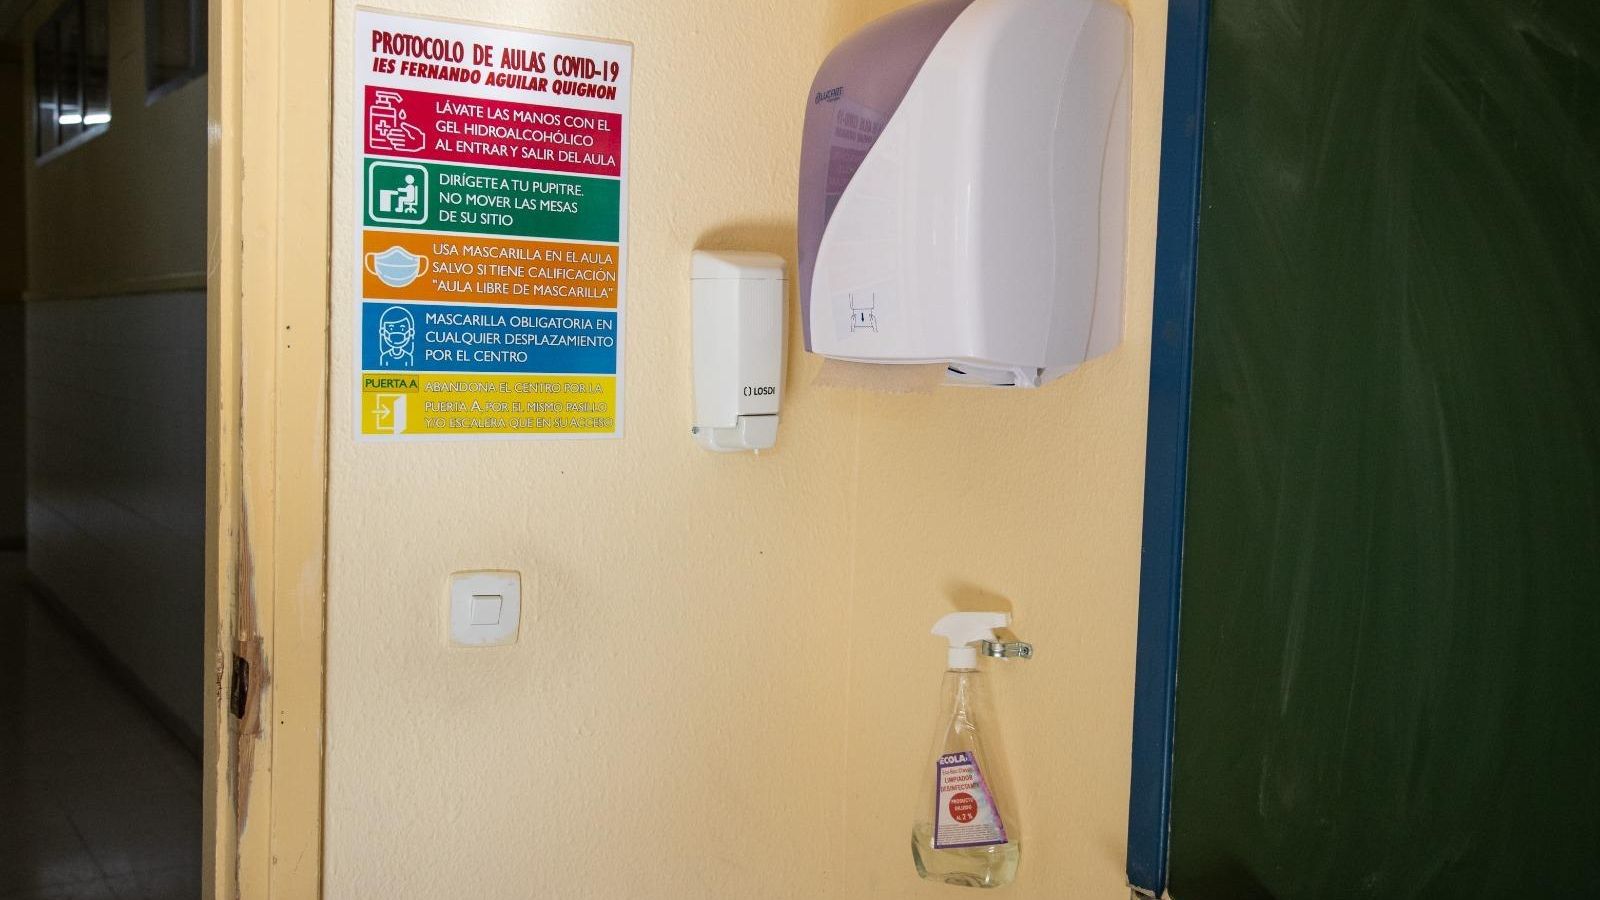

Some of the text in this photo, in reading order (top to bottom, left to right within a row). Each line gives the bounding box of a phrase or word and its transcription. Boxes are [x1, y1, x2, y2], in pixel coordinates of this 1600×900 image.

[372, 30, 619, 82] PROTOCOLO DE AULAS COVID-19
[373, 58, 616, 100] IES FERNANDO AGUILAR QUIGNON
[436, 101, 610, 131] LÁVATE LAS MANOS CON EL
[436, 121, 593, 146] GEL HIDROALCOHÓLICO
[435, 139, 615, 166] AL ENTRAR Y SALIR DEL AULA
[440, 173, 584, 196] DIRÍGETE A TU PUPITRE.
[440, 193, 577, 213] NO MOVER LAS MESAS
[440, 210, 513, 226] DE SU SITIO
[433, 243, 612, 264] USA MASCARILLA EN EL AULA
[433, 262, 615, 281] SALVO SI TIENE CALIFICACIÓN
[433, 279, 613, 298] "AULA LIBRE DE MASCARILLA"
[426, 313, 612, 330] MASCARILLA OBLIGATORIA EN
[426, 332, 613, 347] CUALQUIER DESPLAZAMIENTO
[426, 350, 527, 362] POR EL CENTRO
[365, 379, 417, 388] PUERTA A
[425, 383, 602, 393] ABANDONA EL CENTRO POR LA
[754, 387, 775, 395] LOSDI
[425, 402, 467, 412] PUERTA
[486, 403, 508, 412] POR
[512, 403, 525, 412] EL
[527, 403, 562, 412] MISMO
[566, 402, 607, 412] PASILLO
[425, 418, 612, 428] Y/O ESCALERA QUE EN SU ACCESO
